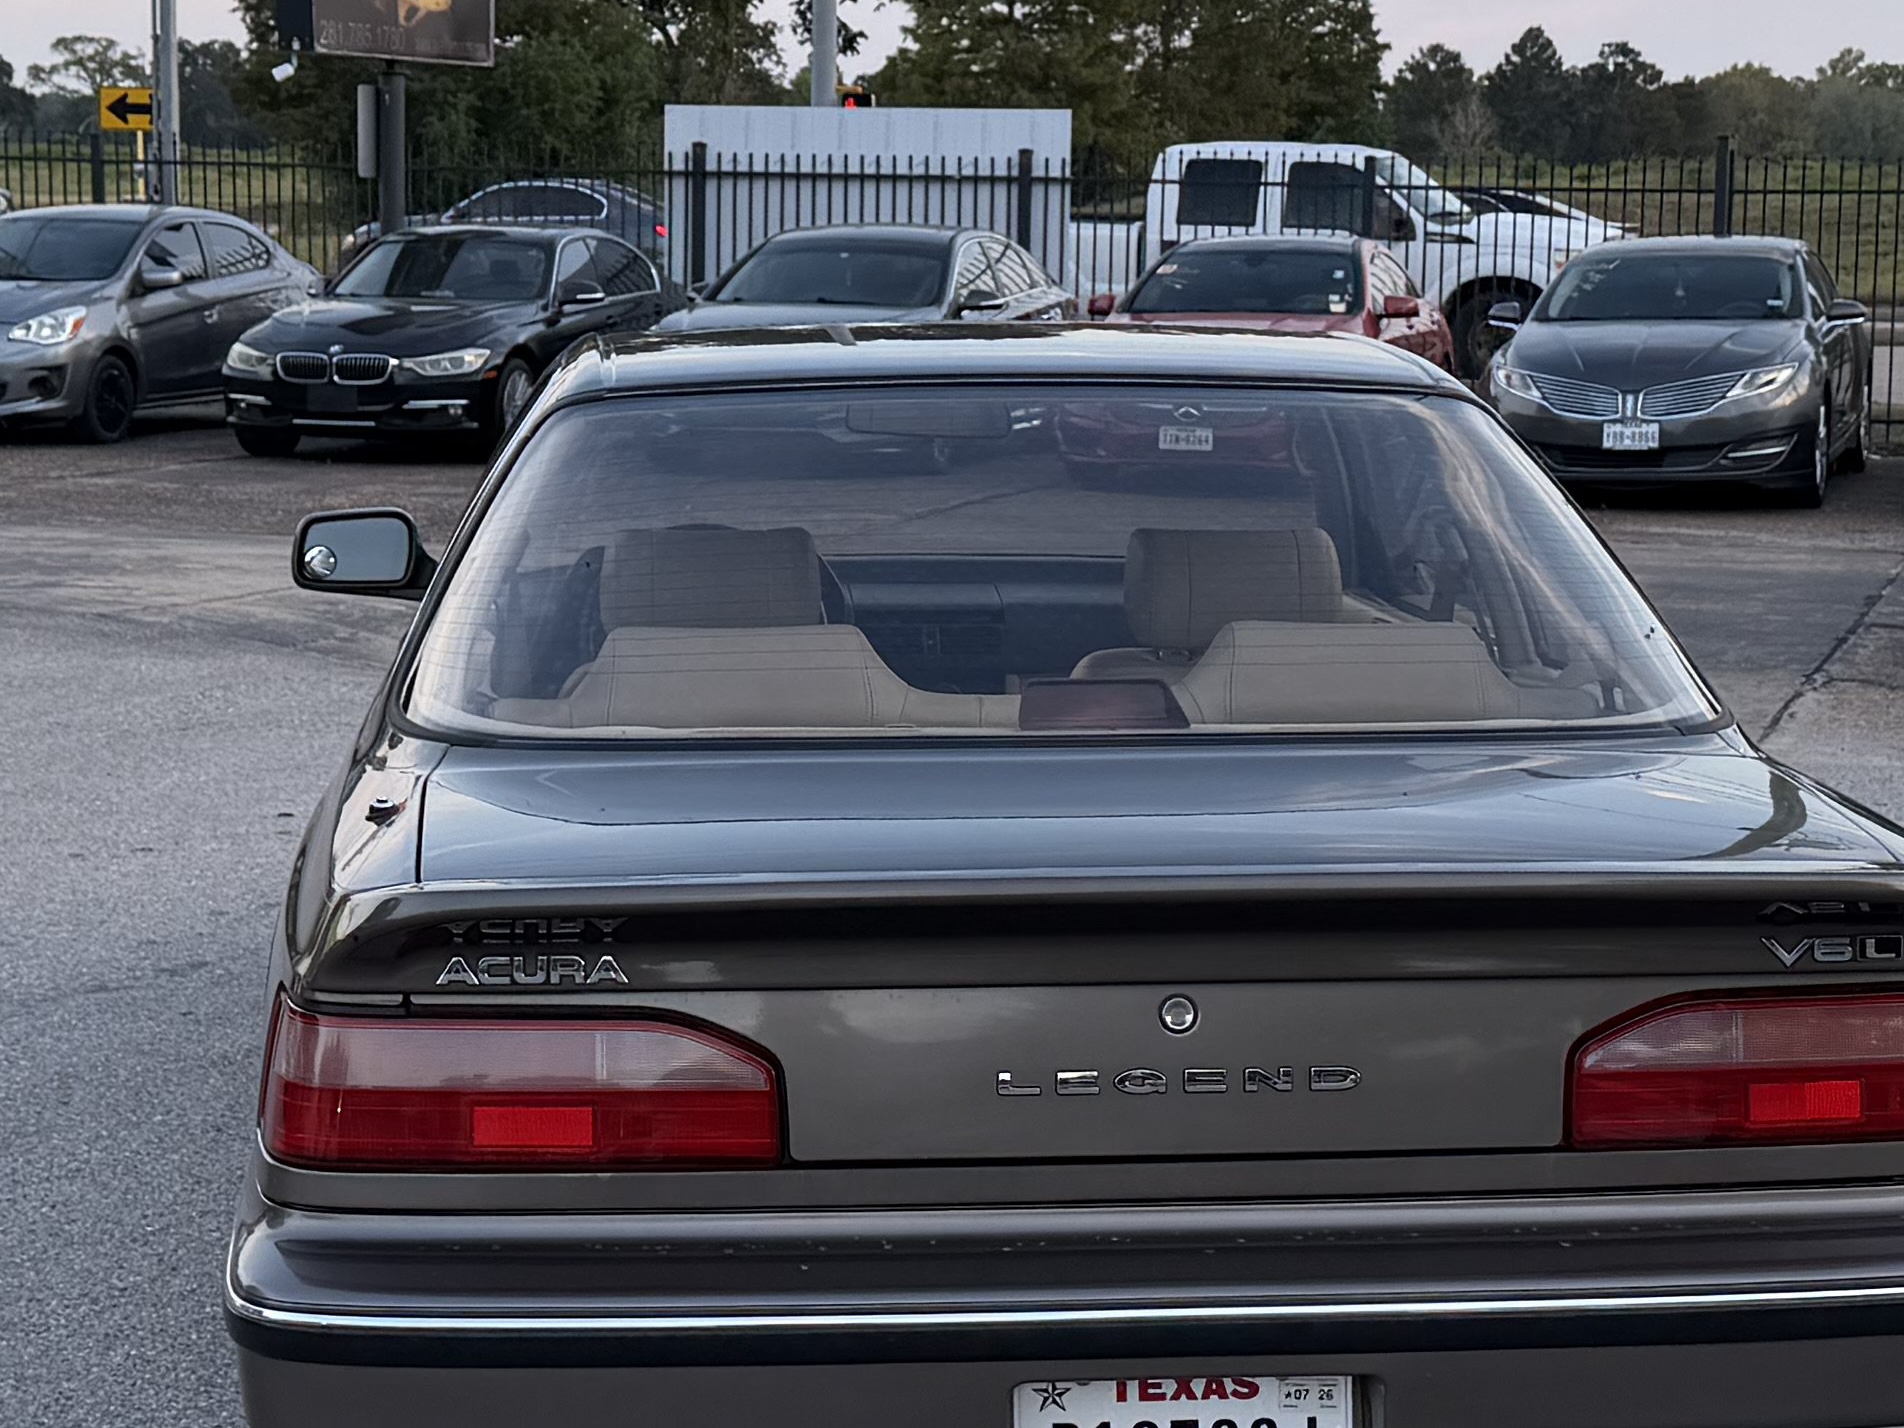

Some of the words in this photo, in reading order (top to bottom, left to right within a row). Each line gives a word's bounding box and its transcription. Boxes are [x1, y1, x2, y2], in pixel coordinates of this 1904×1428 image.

[435, 955, 629, 985] ACURA
[996, 1065, 1362, 1096] LEGEND
[1115, 1378, 1260, 1403] TEXAS
